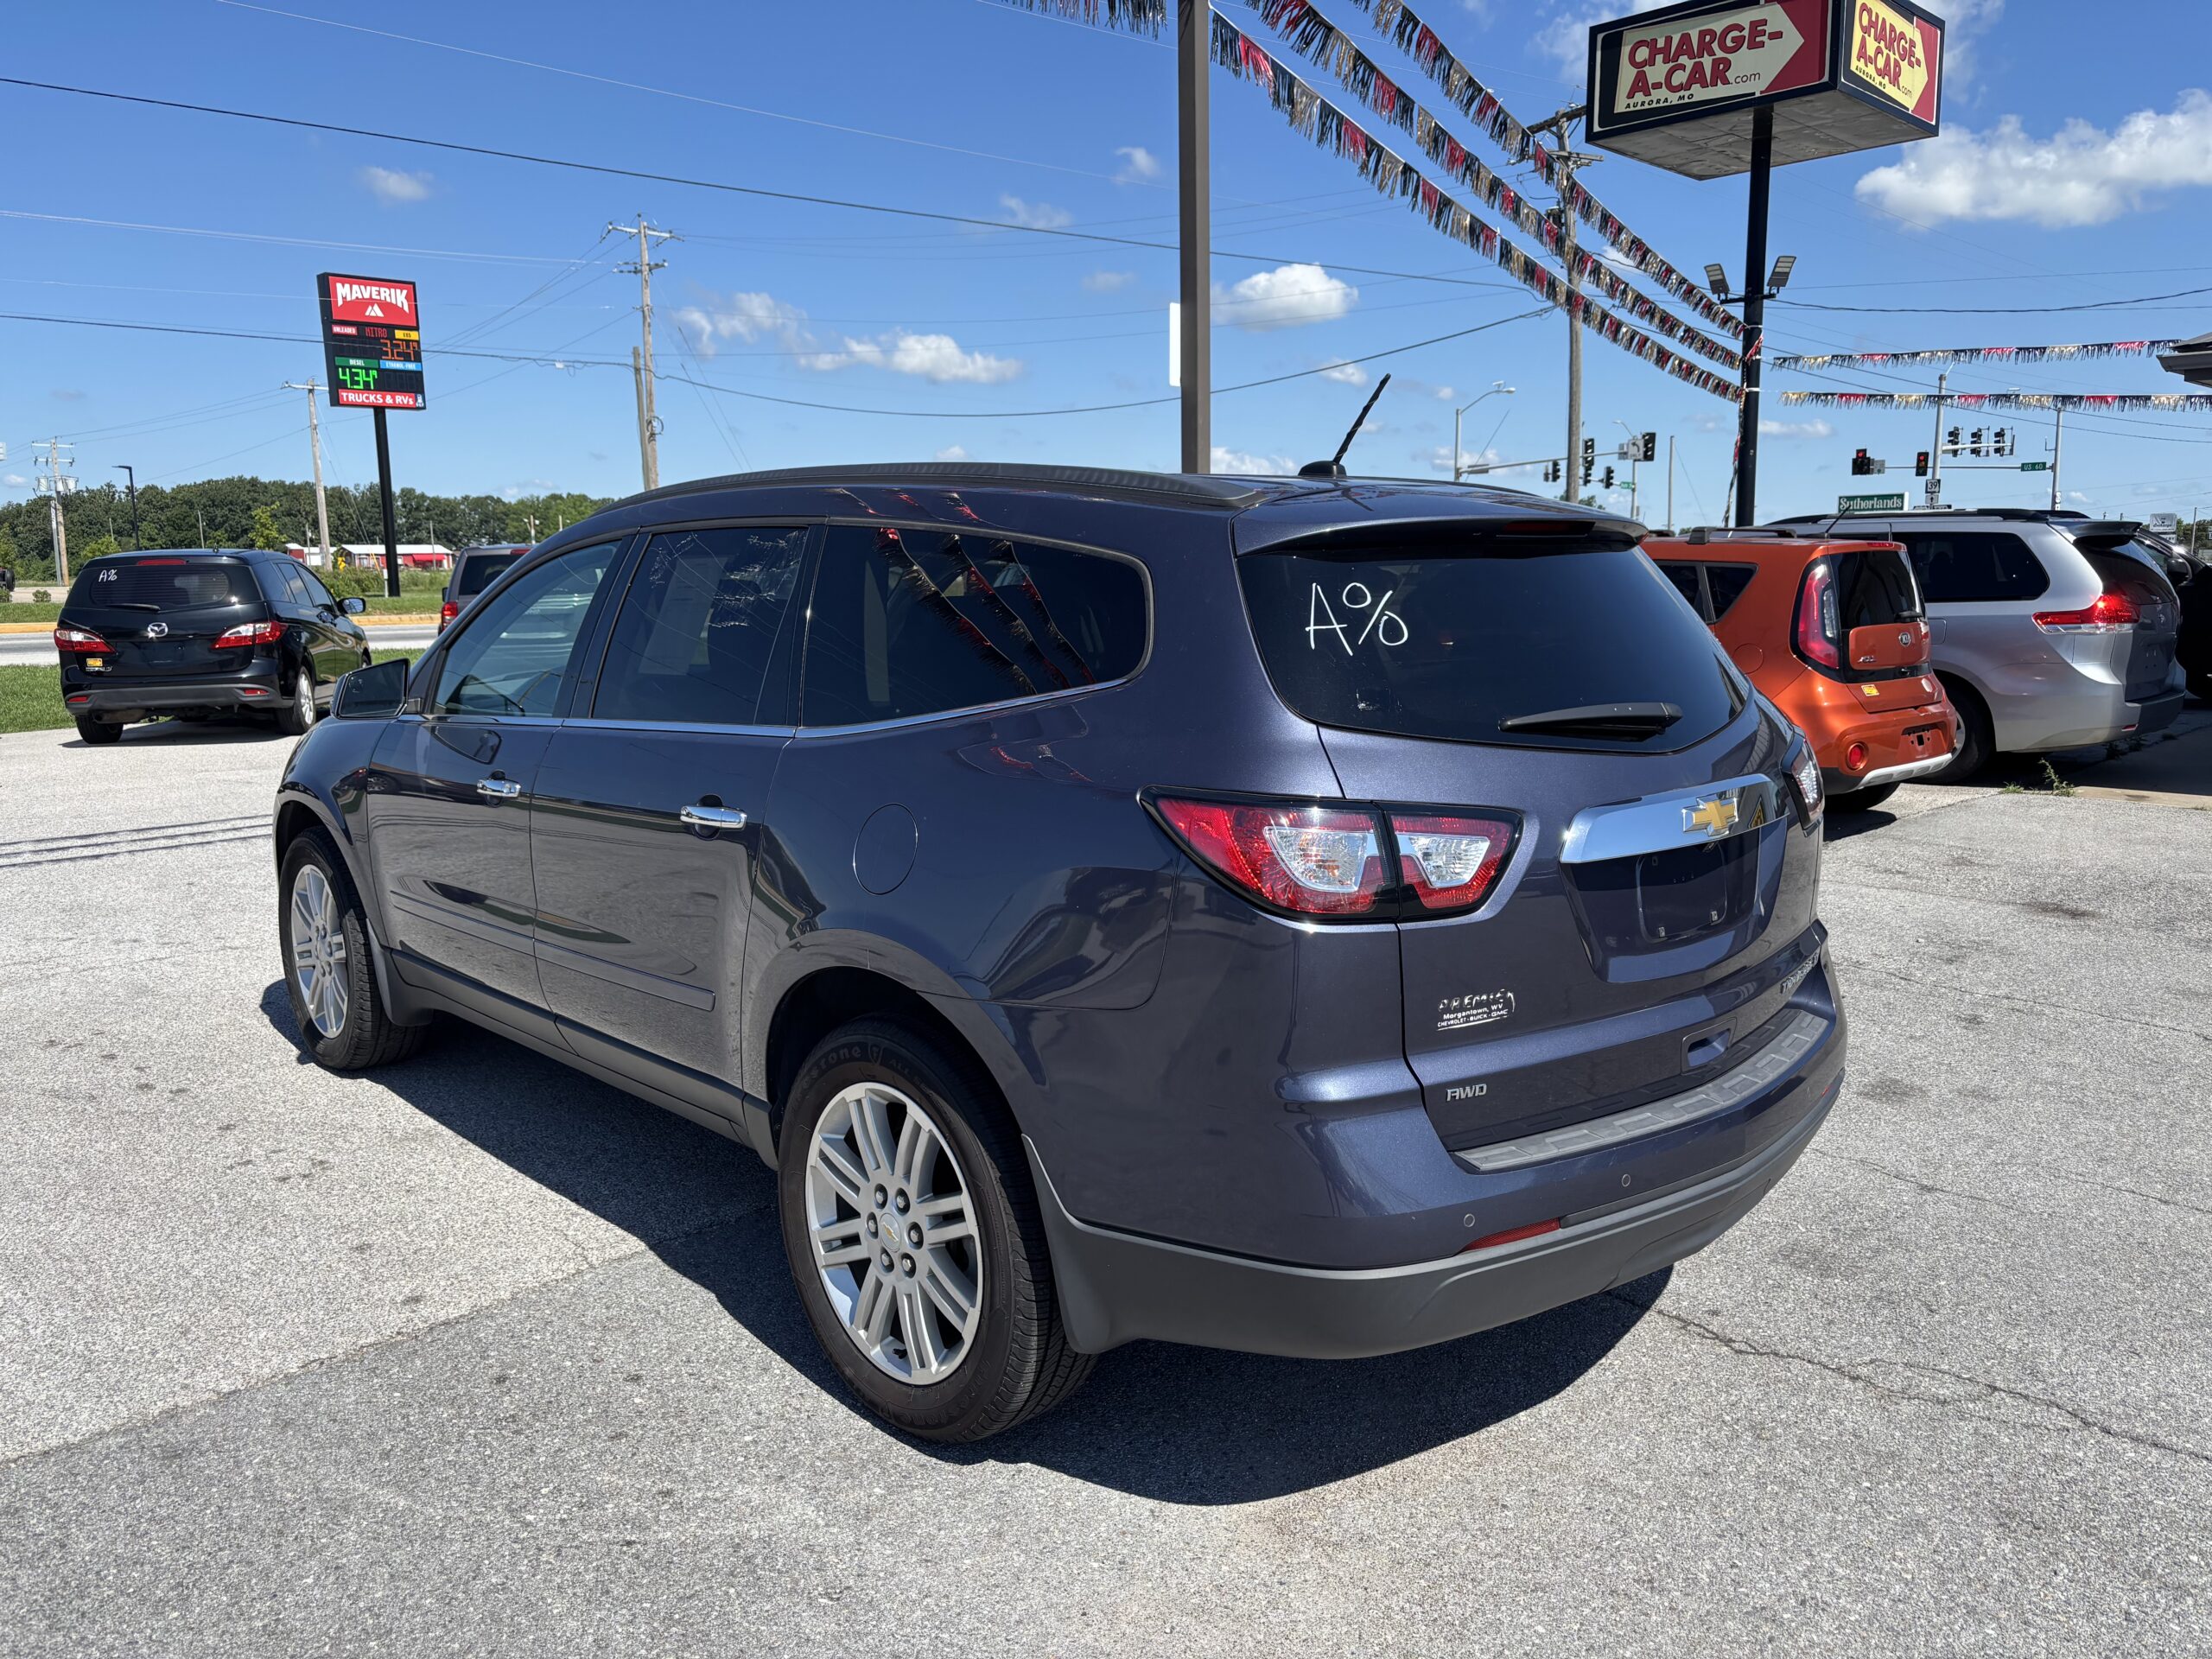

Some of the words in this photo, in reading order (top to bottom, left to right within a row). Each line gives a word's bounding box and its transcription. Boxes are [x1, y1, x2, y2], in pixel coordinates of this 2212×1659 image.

[1628, 18, 1783, 69] CHARGE-
[1859, 2, 1922, 69] CHARGE-
[1855, 65, 1878, 85] AURORA,
[1878, 81, 1886, 90] MO
[1624, 97, 1673, 109] AURORA,
[1677, 92, 1694, 102] MO
[335, 283, 410, 314] MAVERIK
[333, 326, 356, 334] UNLEADED
[365, 327, 388, 338] NITRO
[340, 392, 383, 404] TRUCKS
[385, 395, 393, 404] &
[396, 395, 414, 405] RVs
[1928, 480, 1938, 491] 39
[1840, 496, 1903, 511] Sutherlands
[98, 569, 118, 582] A%
[1305, 582, 1408, 657] A%
[1443, 1007, 1489, 1020] Morgantown,
[1491, 1002, 1503, 1011] WV
[1446, 1084, 1487, 1102] AWD
